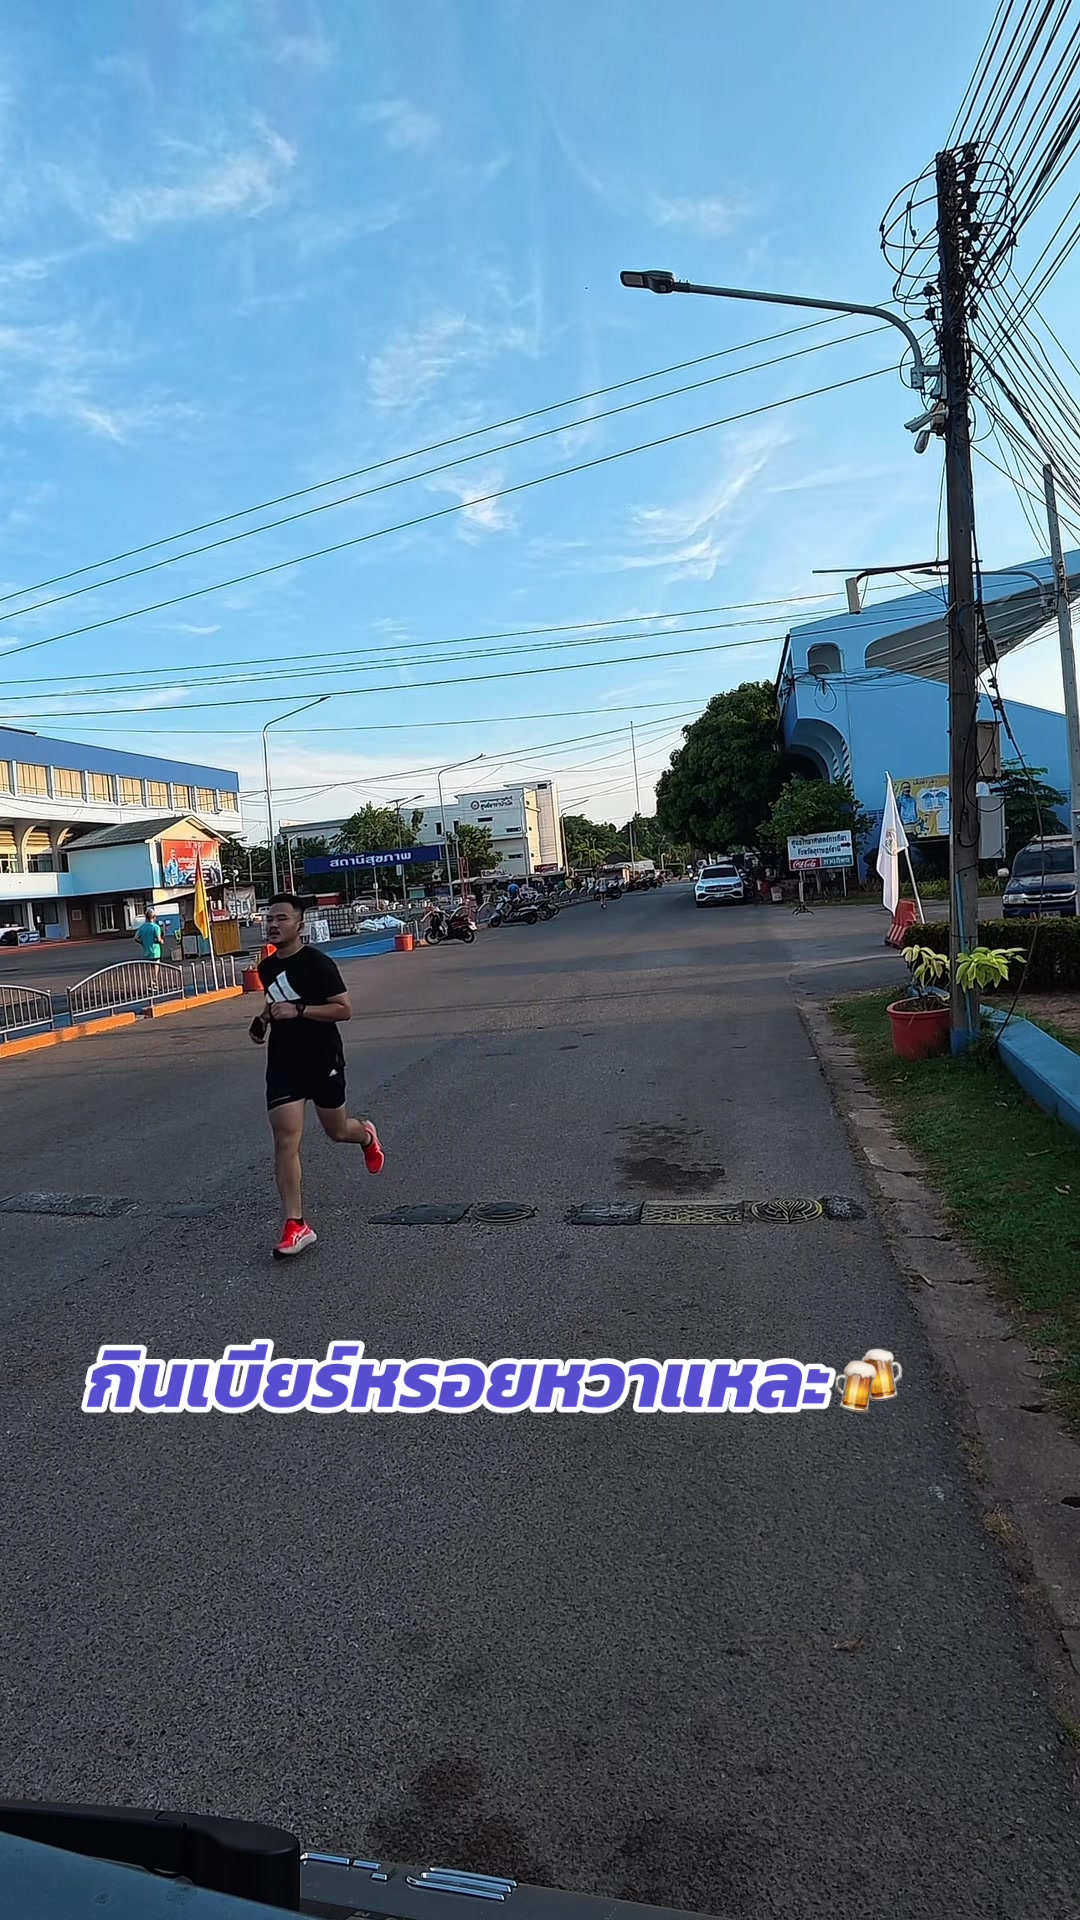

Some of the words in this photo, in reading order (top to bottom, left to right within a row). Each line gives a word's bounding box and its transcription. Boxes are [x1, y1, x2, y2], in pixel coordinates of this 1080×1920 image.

[330, 852, 411, 867] สถานีสุขภาพ
